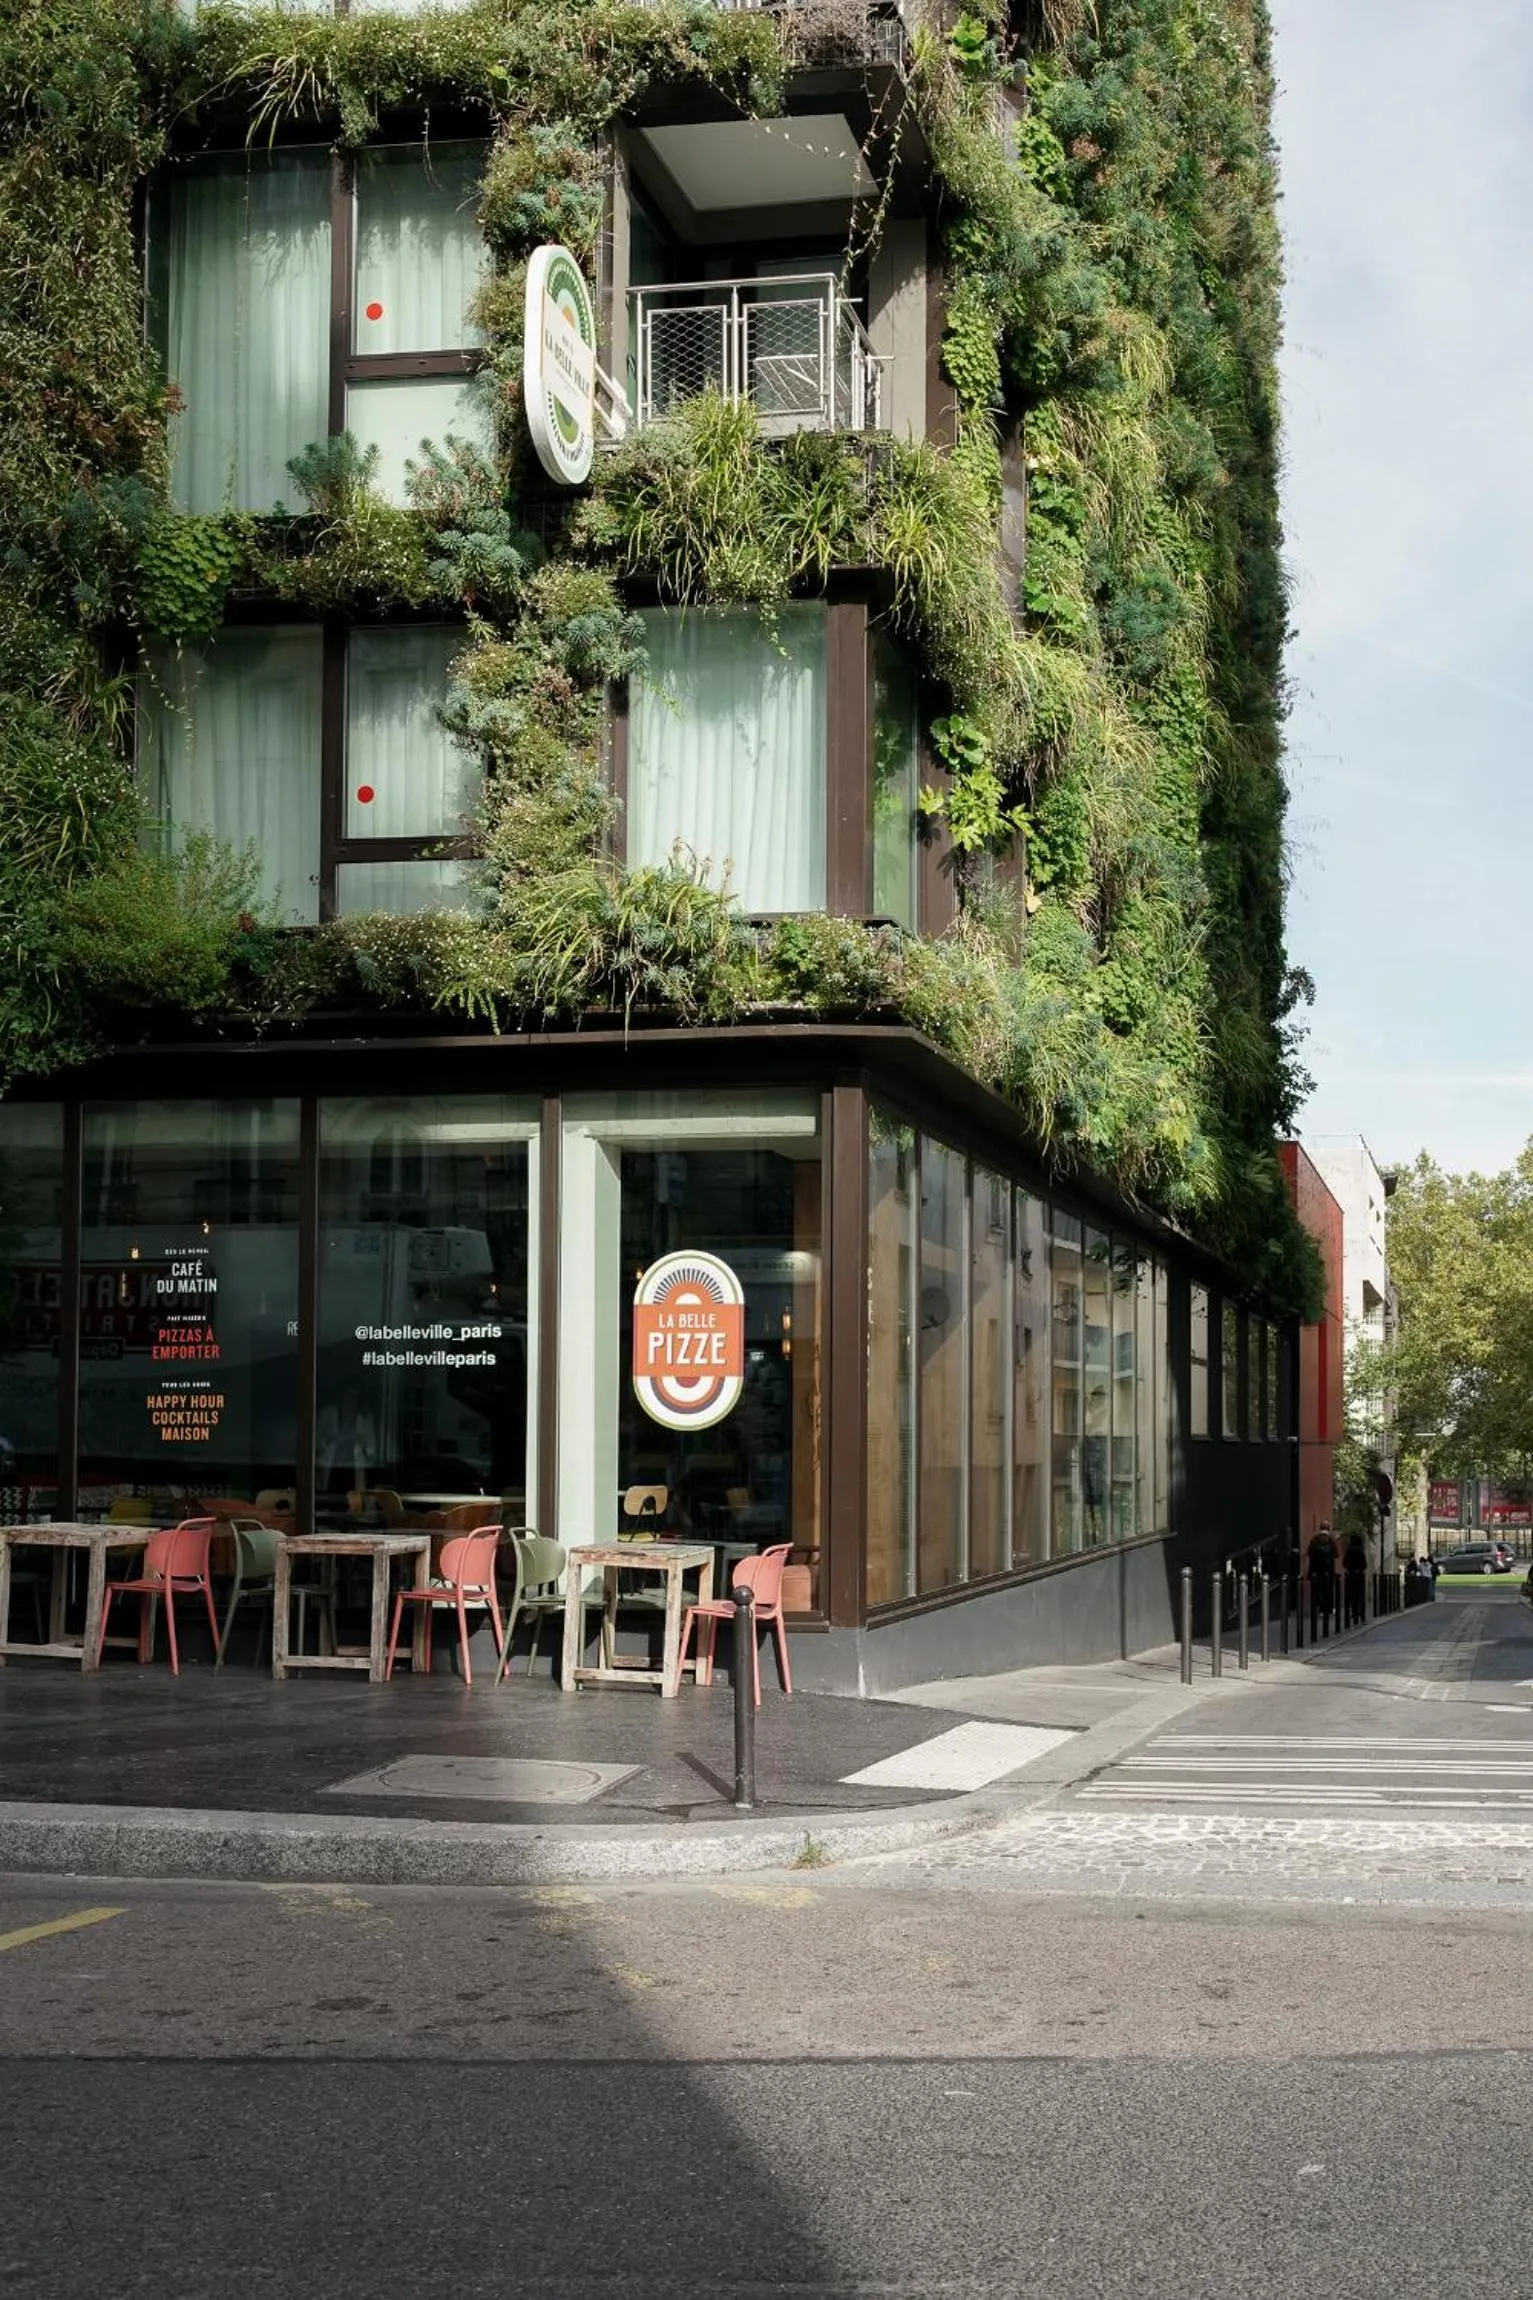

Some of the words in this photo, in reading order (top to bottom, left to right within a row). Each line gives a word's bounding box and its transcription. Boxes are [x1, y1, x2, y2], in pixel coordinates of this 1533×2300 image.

[554, 341, 573, 377] BELLE
[574, 367, 590, 397] VILLE
[171, 1259, 203, 1277] CAFÉ
[157, 1279, 174, 1293] DU
[177, 1278, 217, 1293] MATIN
[658, 1313, 674, 1329] LA
[679, 1313, 717, 1329] BELLE
[159, 1328, 202, 1342] PIZZAS
[355, 1323, 502, 1341] @labelleville_paris
[152, 1345, 220, 1360] EMPORTER
[647, 1331, 728, 1365] PIZZE
[362, 1350, 496, 1368] #labellevilleparis
[146, 1395, 187, 1409] HAPPY
[191, 1394, 225, 1409] HOUR
[152, 1411, 219, 1425] COCKTAILS
[161, 1426, 209, 1441] MAISON
